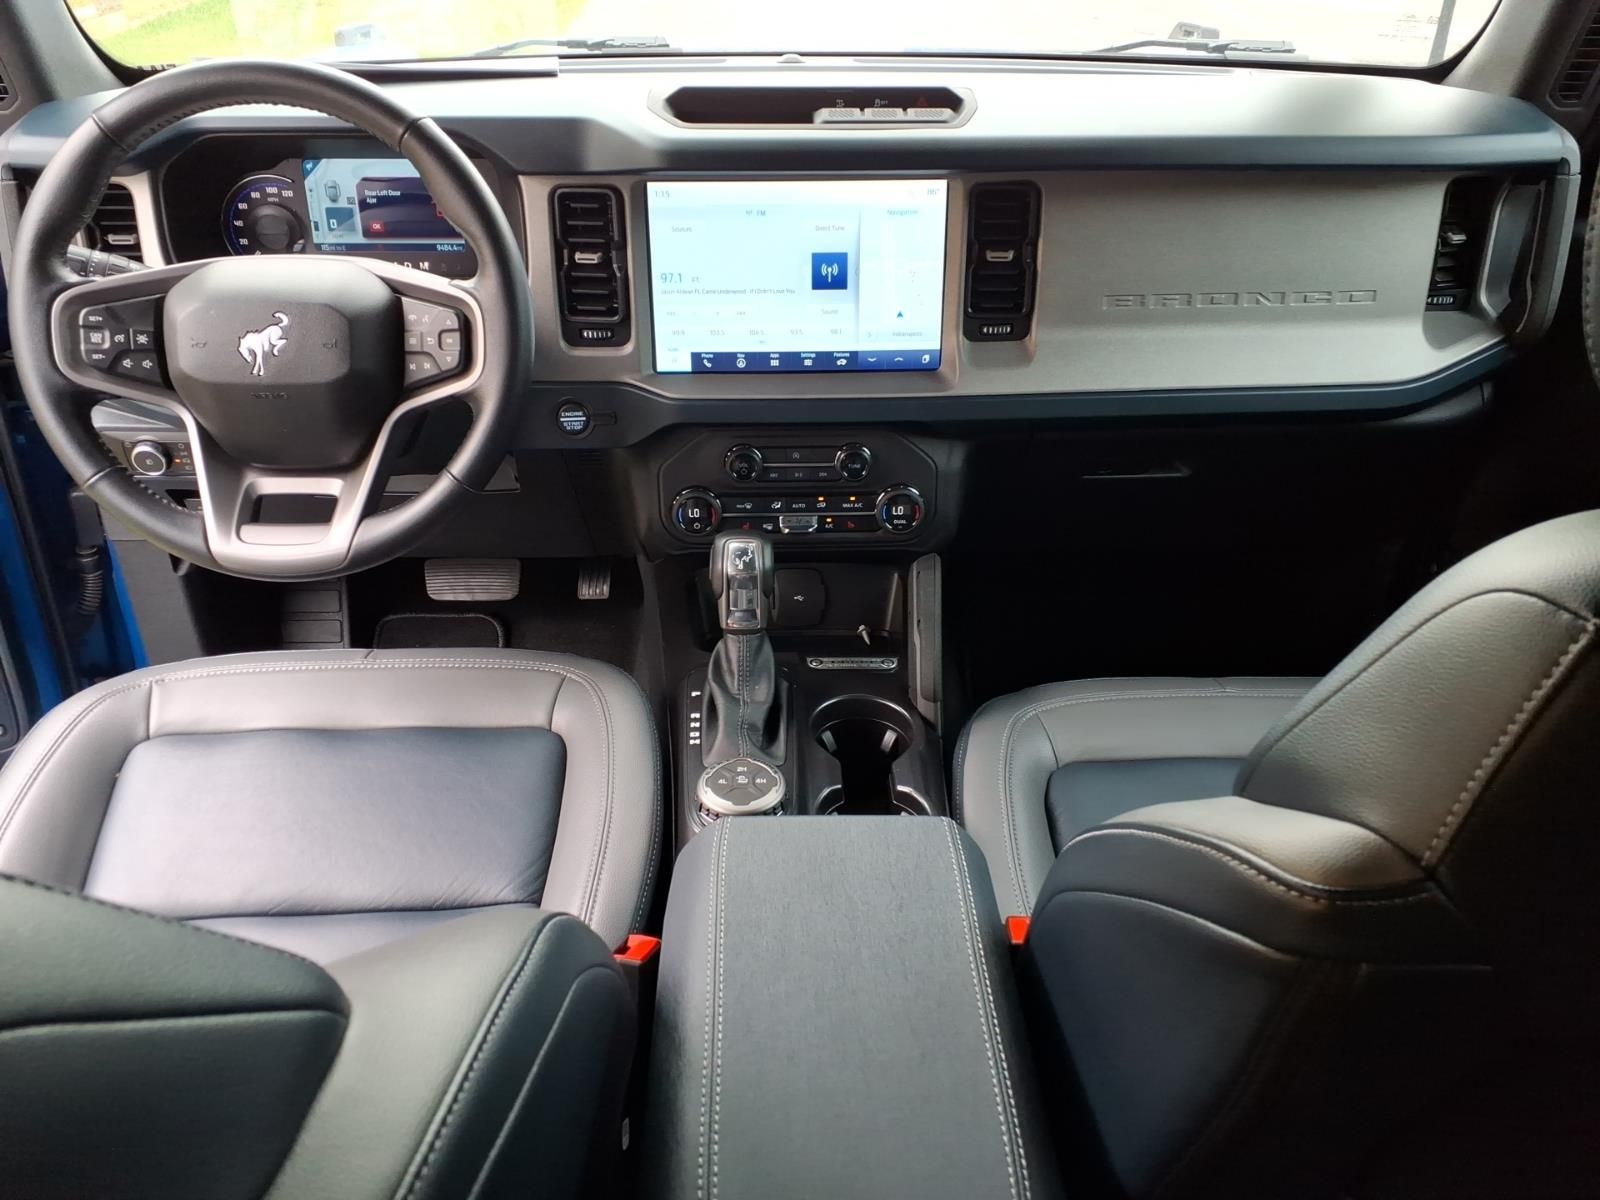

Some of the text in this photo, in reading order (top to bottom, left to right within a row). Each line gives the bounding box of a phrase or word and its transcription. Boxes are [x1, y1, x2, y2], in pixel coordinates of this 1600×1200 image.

[655, 190, 670, 198] 1:15
[660, 272, 683, 283] 97.1
[1102, 289, 1378, 311] BRONCO
[688, 508, 700, 518] LO
[892, 505, 904, 515] LO
